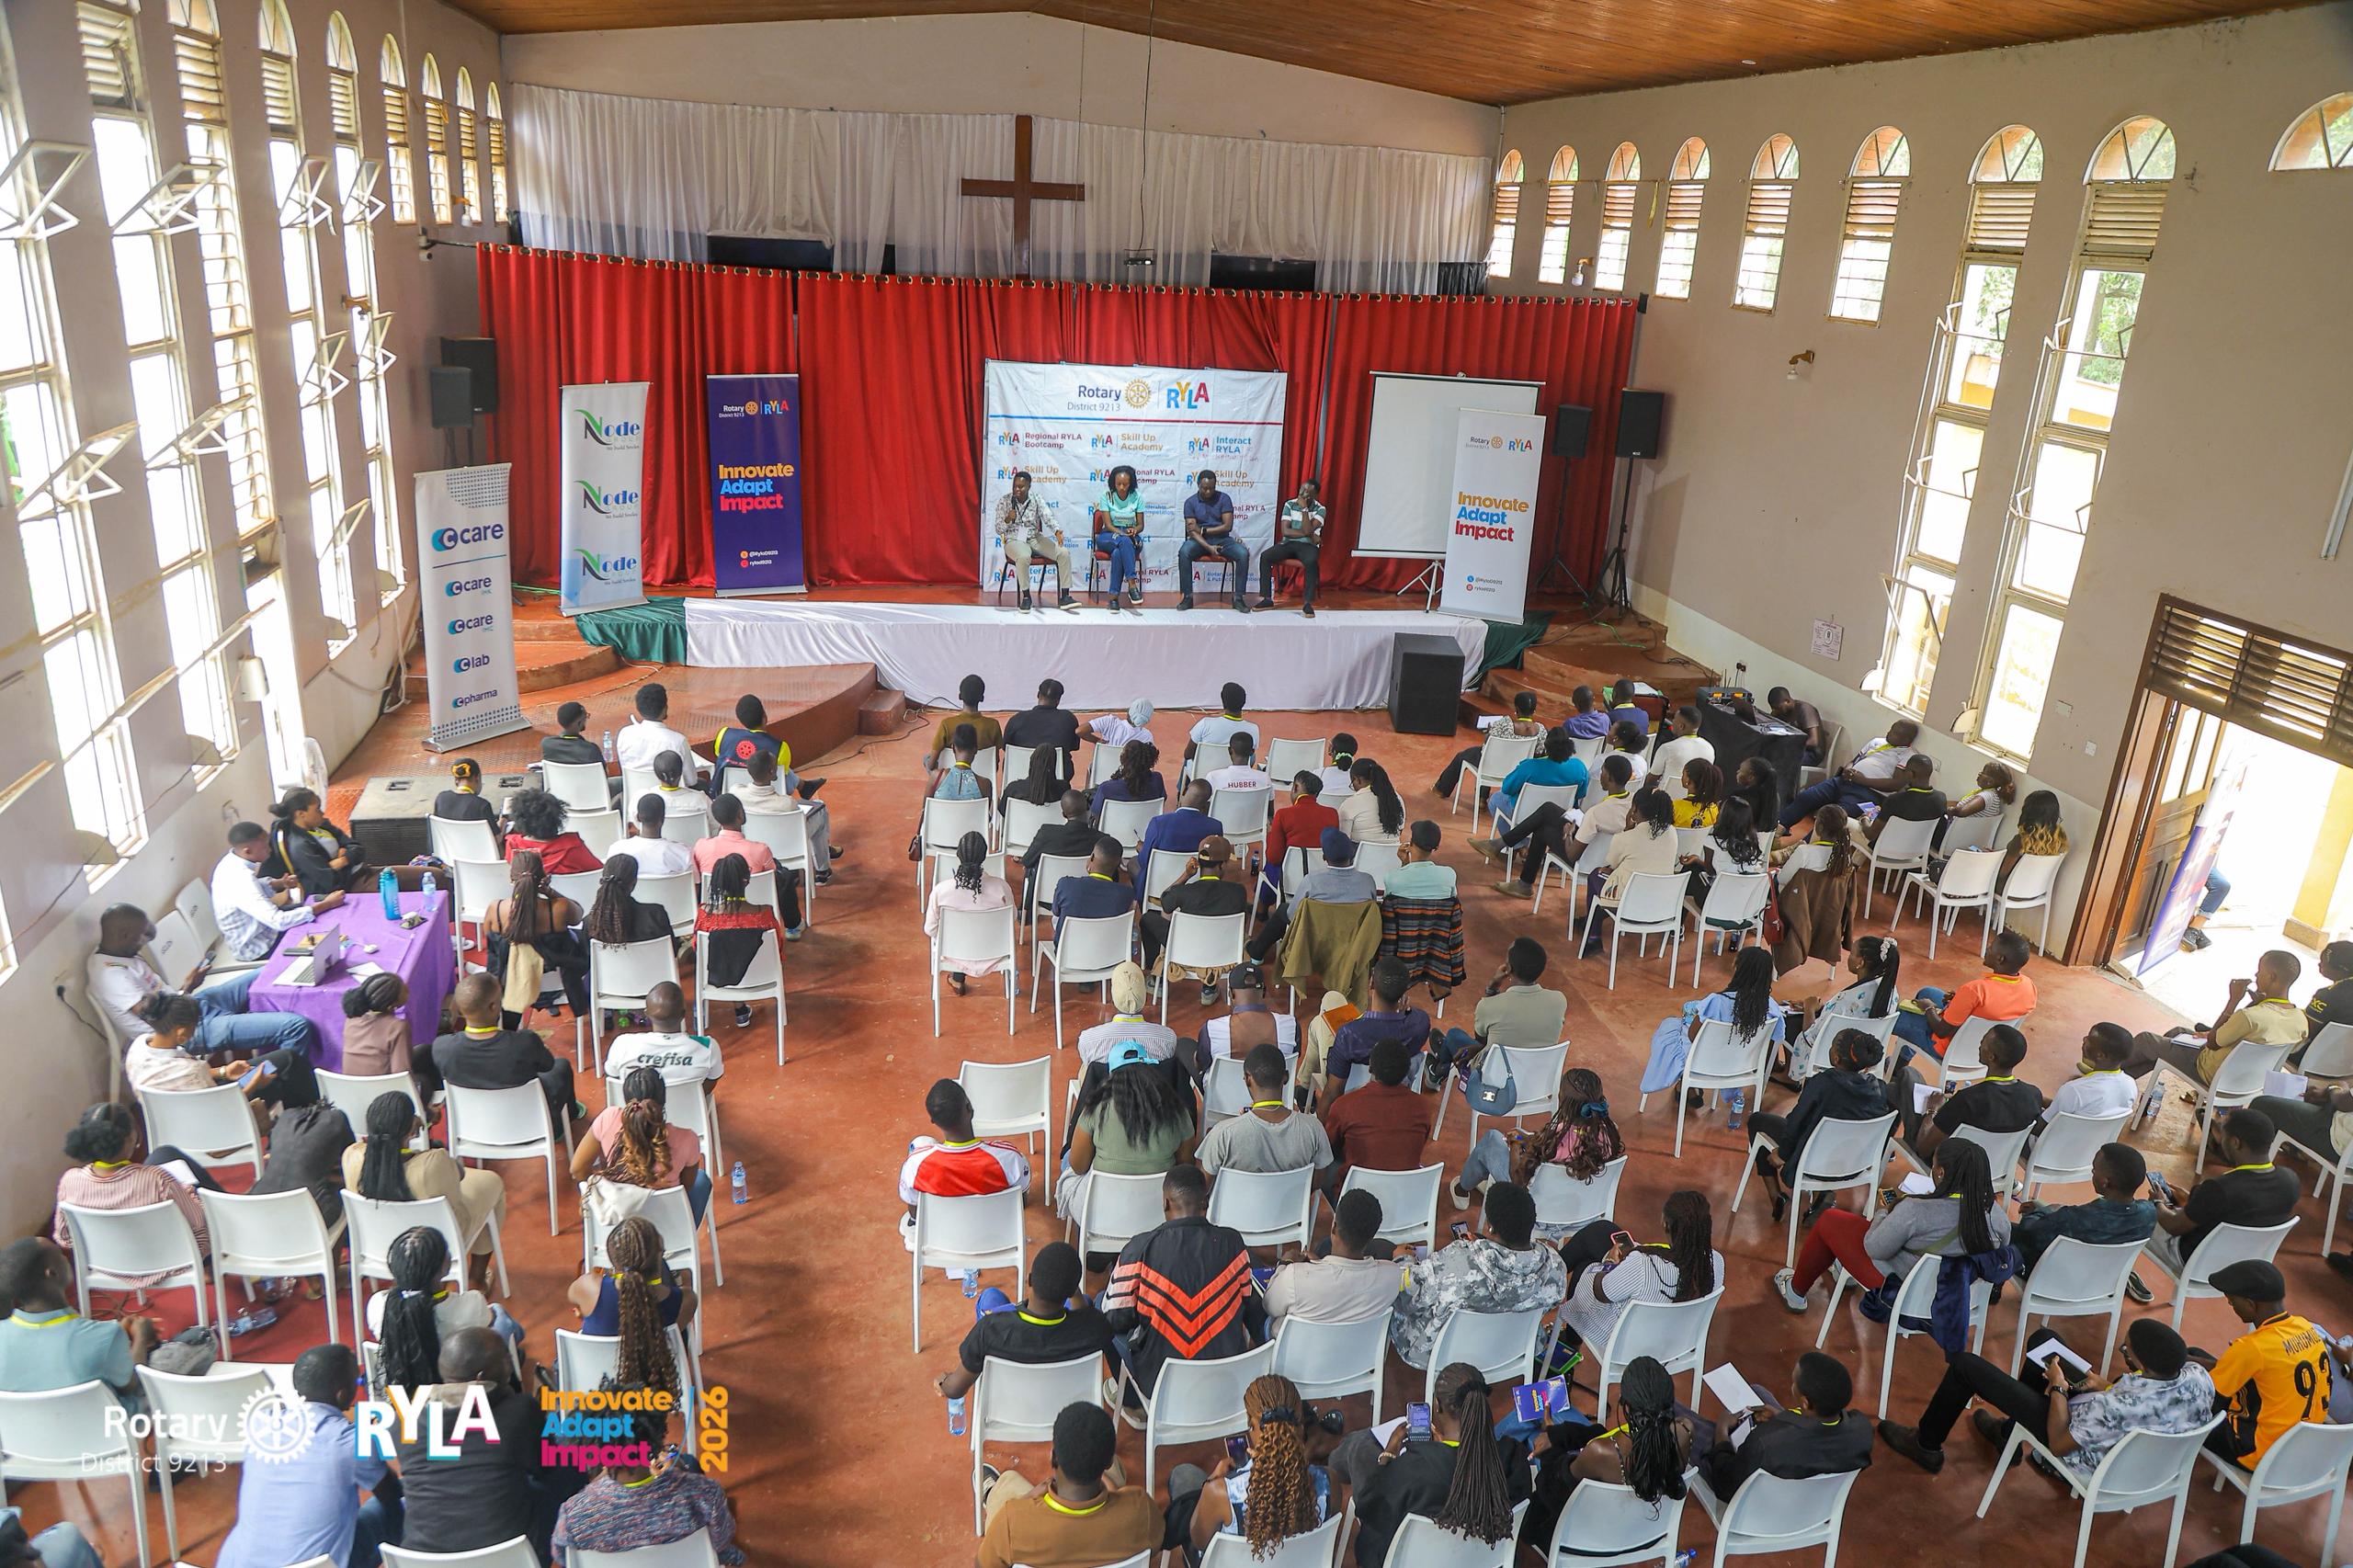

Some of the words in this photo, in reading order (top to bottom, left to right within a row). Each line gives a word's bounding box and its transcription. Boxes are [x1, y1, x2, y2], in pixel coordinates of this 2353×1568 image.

[1078, 385, 1121, 401] Rotary
[1166, 381, 1210, 409] RYLA
[723, 404, 745, 414] Rotary
[765, 400, 789, 415] RYLA
[1067, 402, 1097, 411] District
[1099, 403, 1120, 412] 9213
[574, 409, 641, 446] Node
[998, 430, 1020, 447] RYLA
[1025, 432, 1059, 441] Regional
[1091, 434, 1113, 448] RYLA
[1120, 433, 1140, 441] Skill
[1142, 434, 1156, 442] Up
[1188, 437, 1210, 451] RYLA
[1216, 436, 1252, 445] Interact
[1471, 437, 1491, 446] Rotary
[1025, 441, 1064, 449] Bootcamp
[1120, 442, 1164, 451] Academy
[1508, 438, 1532, 452] RYLA
[719, 462, 794, 479] Innovate
[1024, 466, 1043, 474] Skill
[1046, 466, 1059, 474] Up
[1235, 471, 1247, 479] Up
[720, 478, 773, 495] Adapt
[1031, 476, 1067, 484] cademy
[574, 479, 640, 515] Node
[720, 494, 783, 513] Impact
[1458, 491, 1529, 513] Innovate
[1457, 506, 1507, 526] Adapt
[460, 523, 504, 544] care
[1455, 520, 1515, 541] Impact
[574, 549, 638, 581] Node
[463, 577, 492, 591] care
[466, 614, 493, 629] care
[472, 654, 490, 669] lab
[464, 689, 498, 706] pharma
[637, 1051, 693, 1067] crefisa
[2294, 1349, 2333, 1422] 93
